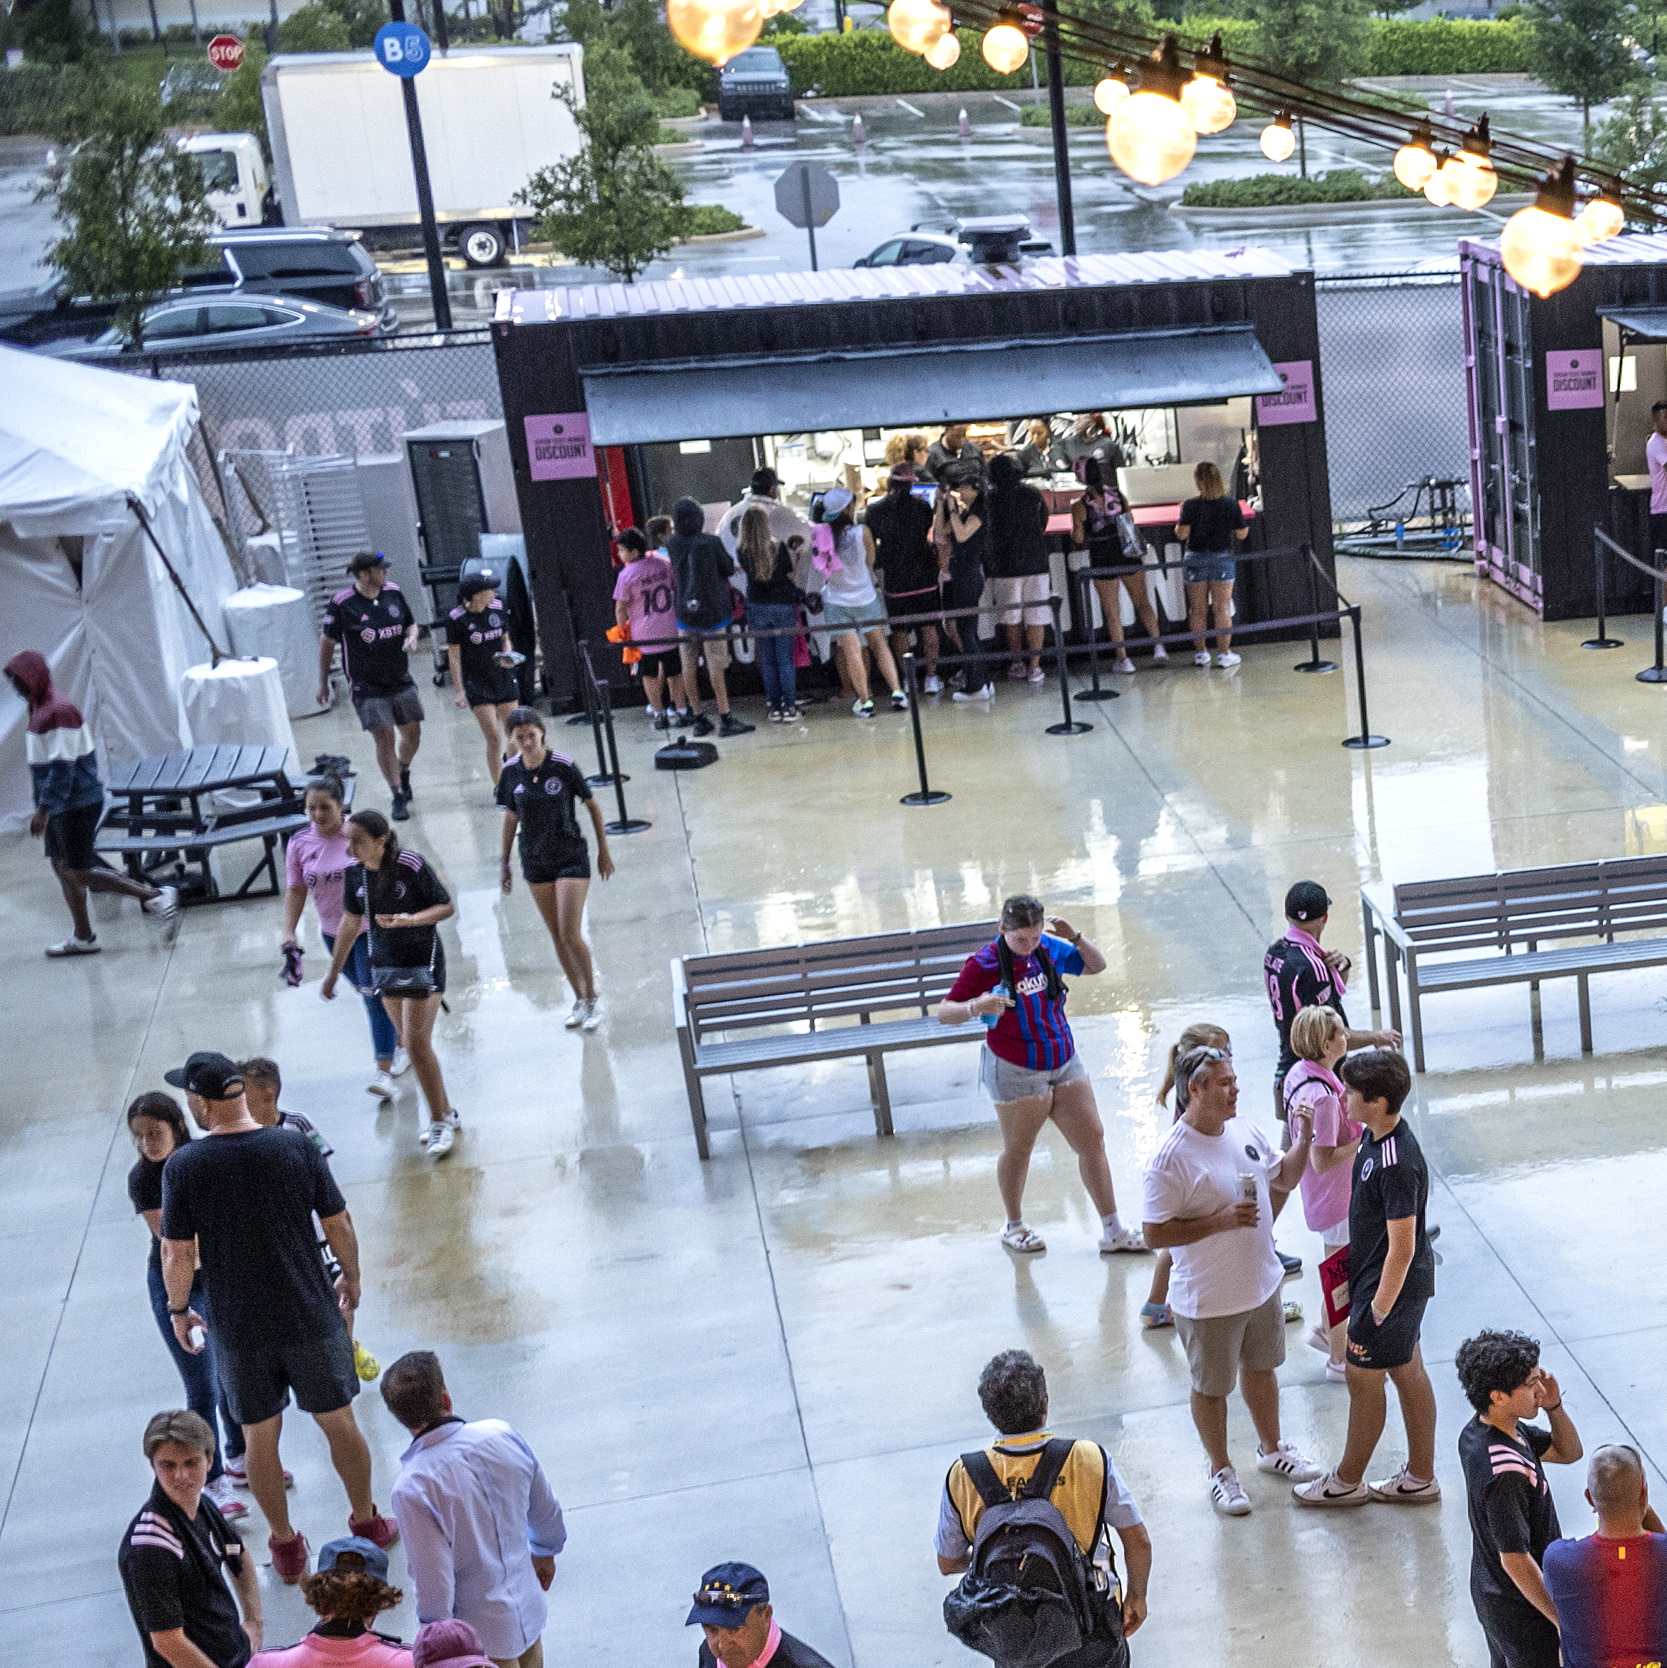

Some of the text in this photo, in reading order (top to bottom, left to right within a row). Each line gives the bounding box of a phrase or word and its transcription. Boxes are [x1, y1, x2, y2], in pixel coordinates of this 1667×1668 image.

[211, 44, 243, 61] STOP
[383, 36, 423, 62] B5
[1553, 376, 1597, 393] DISCOUNT
[534, 442, 587, 461] DISCOUNT
